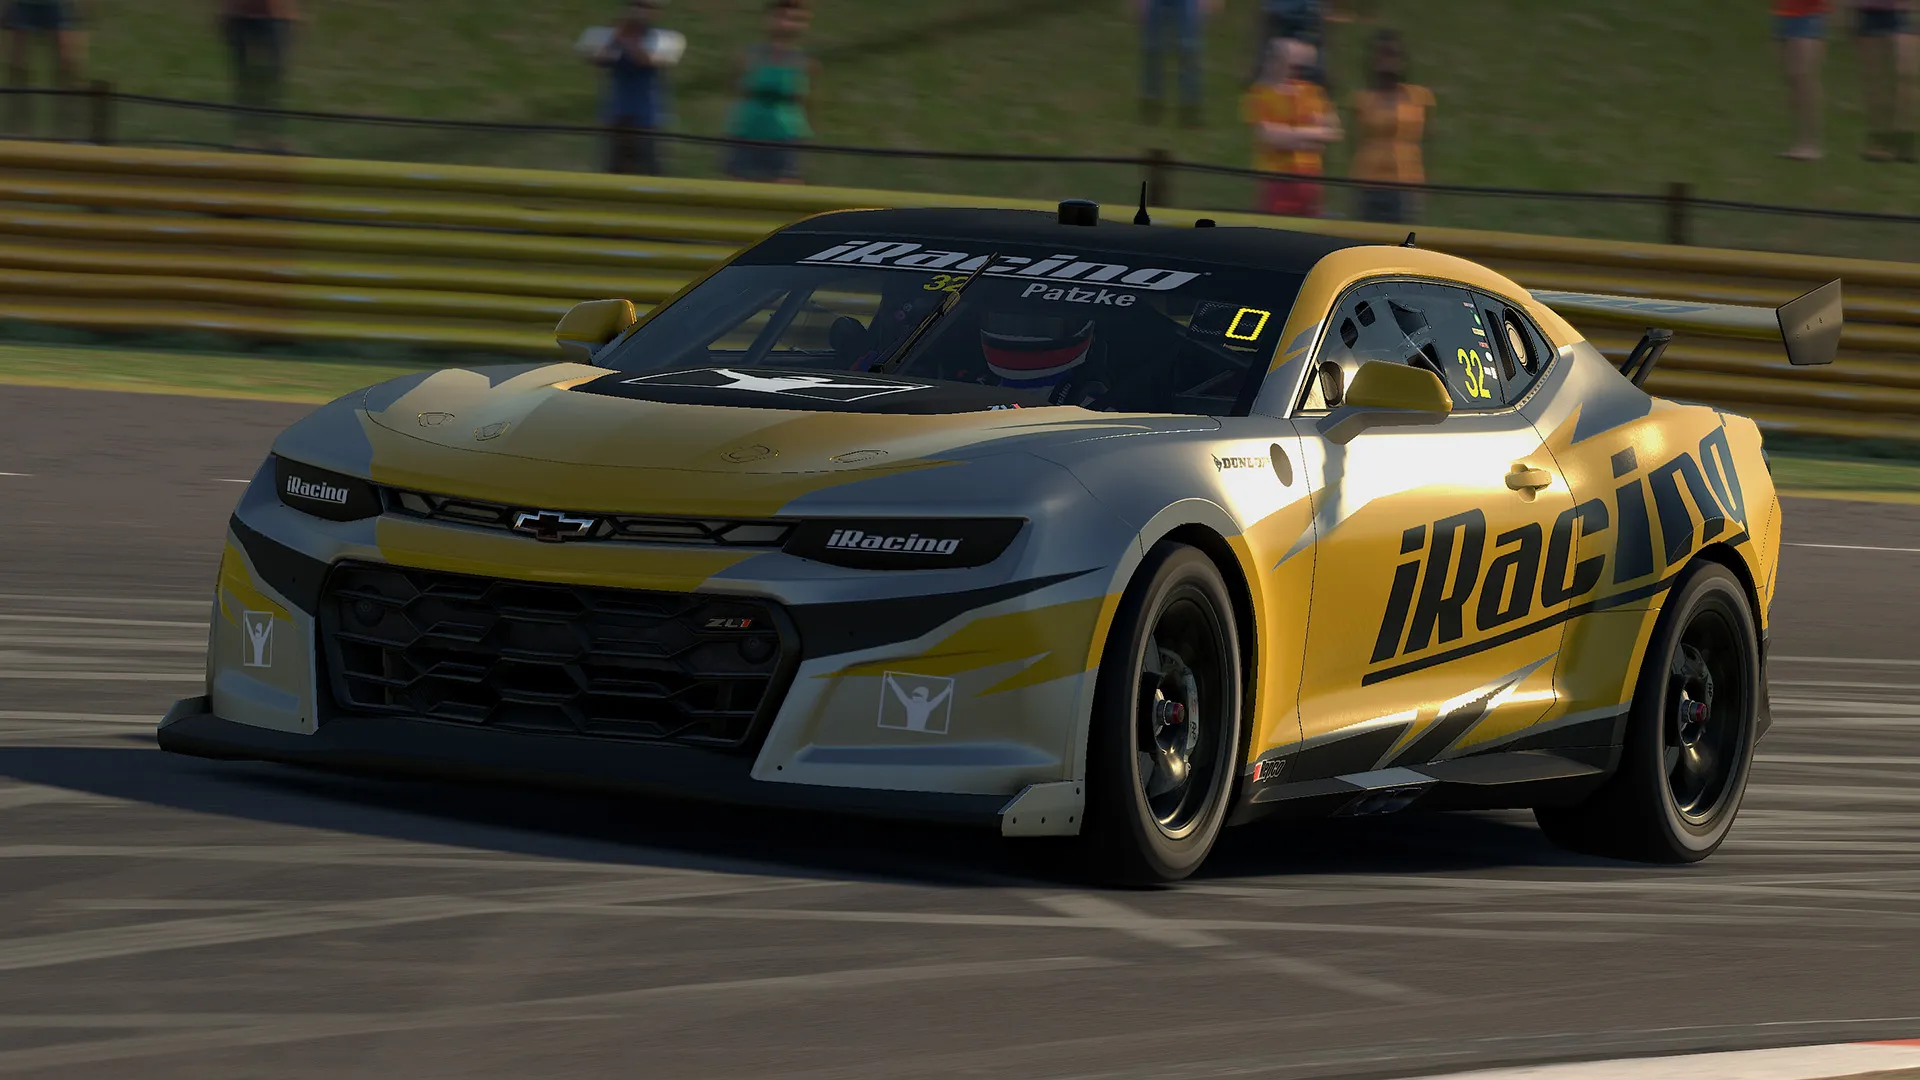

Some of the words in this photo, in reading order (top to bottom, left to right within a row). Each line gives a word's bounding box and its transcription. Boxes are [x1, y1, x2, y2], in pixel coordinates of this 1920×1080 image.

[796, 240, 1202, 290] iRacing
[923, 274, 969, 292] 32
[1021, 283, 1137, 307] Patzke
[1457, 348, 1491, 399] 32
[287, 475, 348, 504] iRacing
[826, 529, 960, 555] iRacing
[1363, 425, 1750, 687] iRacing
[704, 618, 751, 628] ZL1
